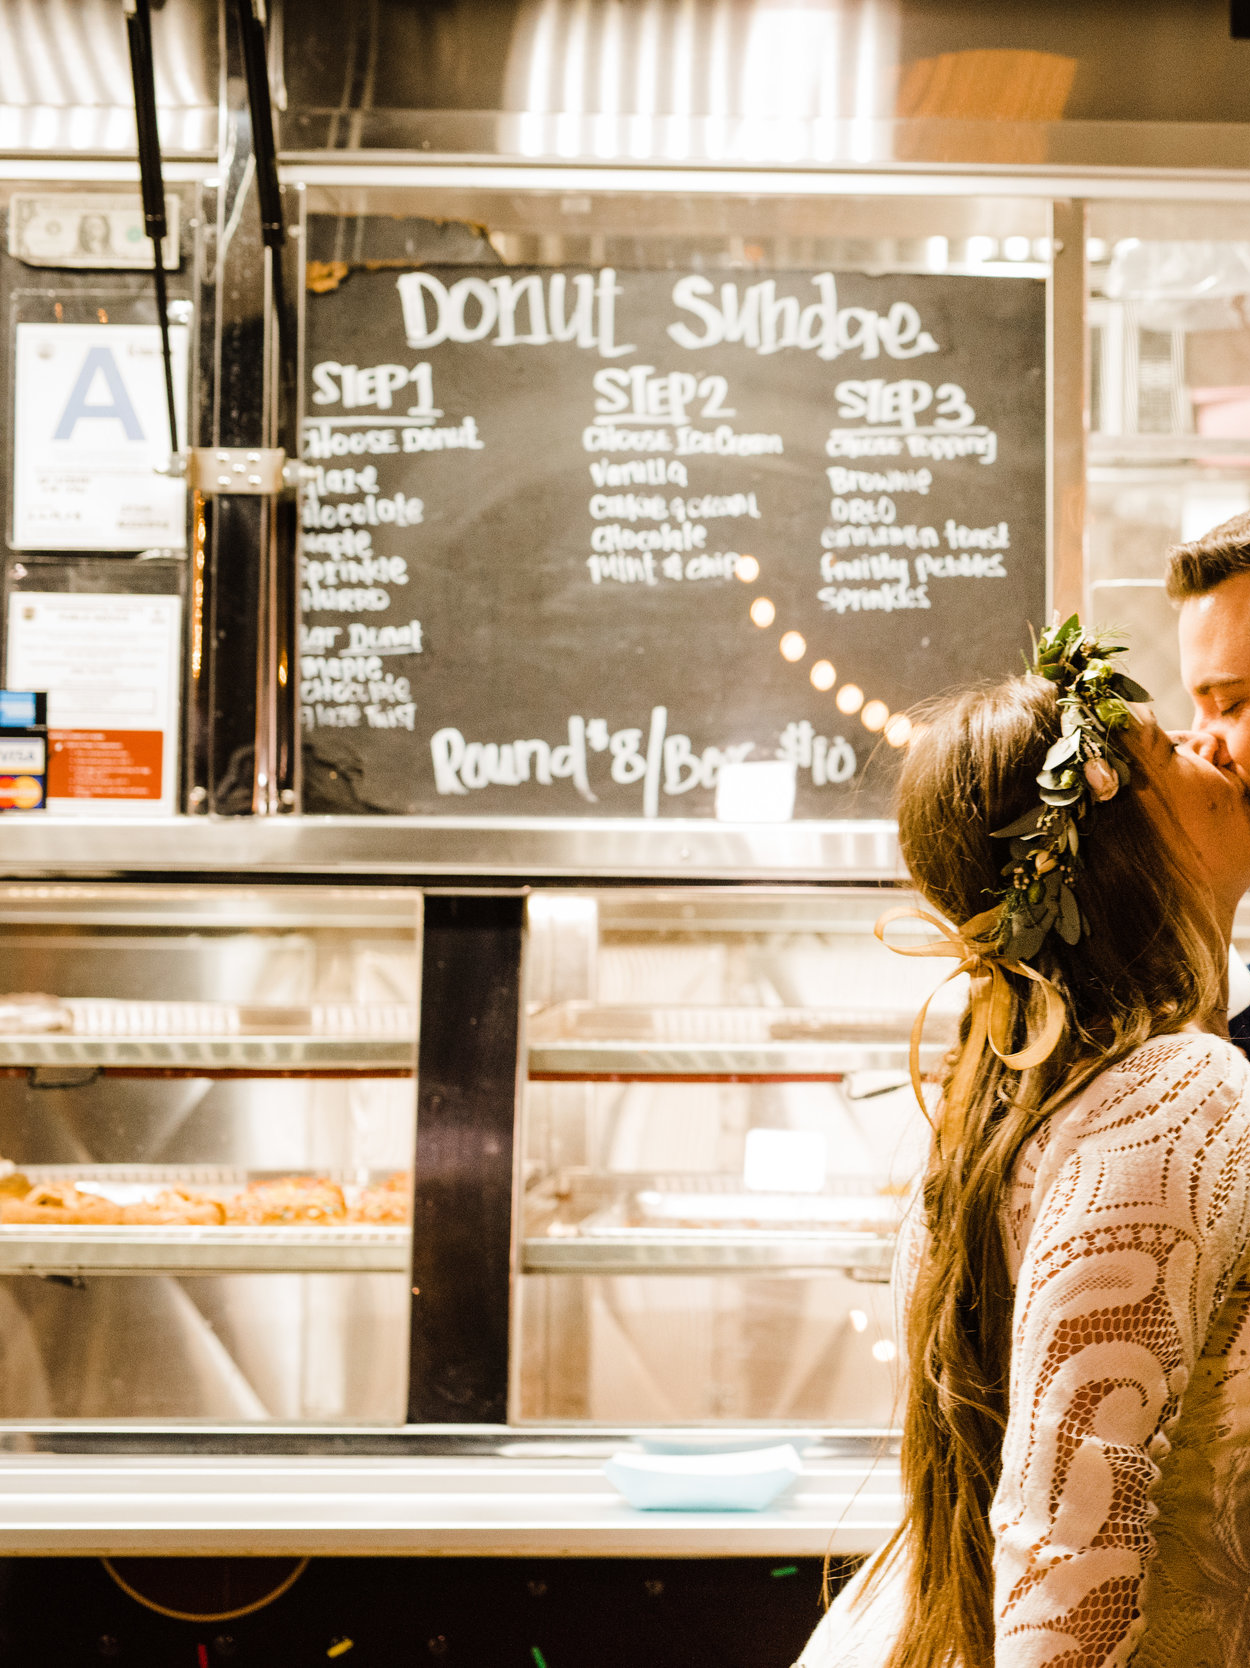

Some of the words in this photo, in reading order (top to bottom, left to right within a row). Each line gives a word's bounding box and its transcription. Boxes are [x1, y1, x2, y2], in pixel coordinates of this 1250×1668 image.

[397, 267, 636, 358] Donut
[666, 272, 939, 360] Sundae
[52, 346, 146, 441] A
[303, 491, 425, 528] hocolate
